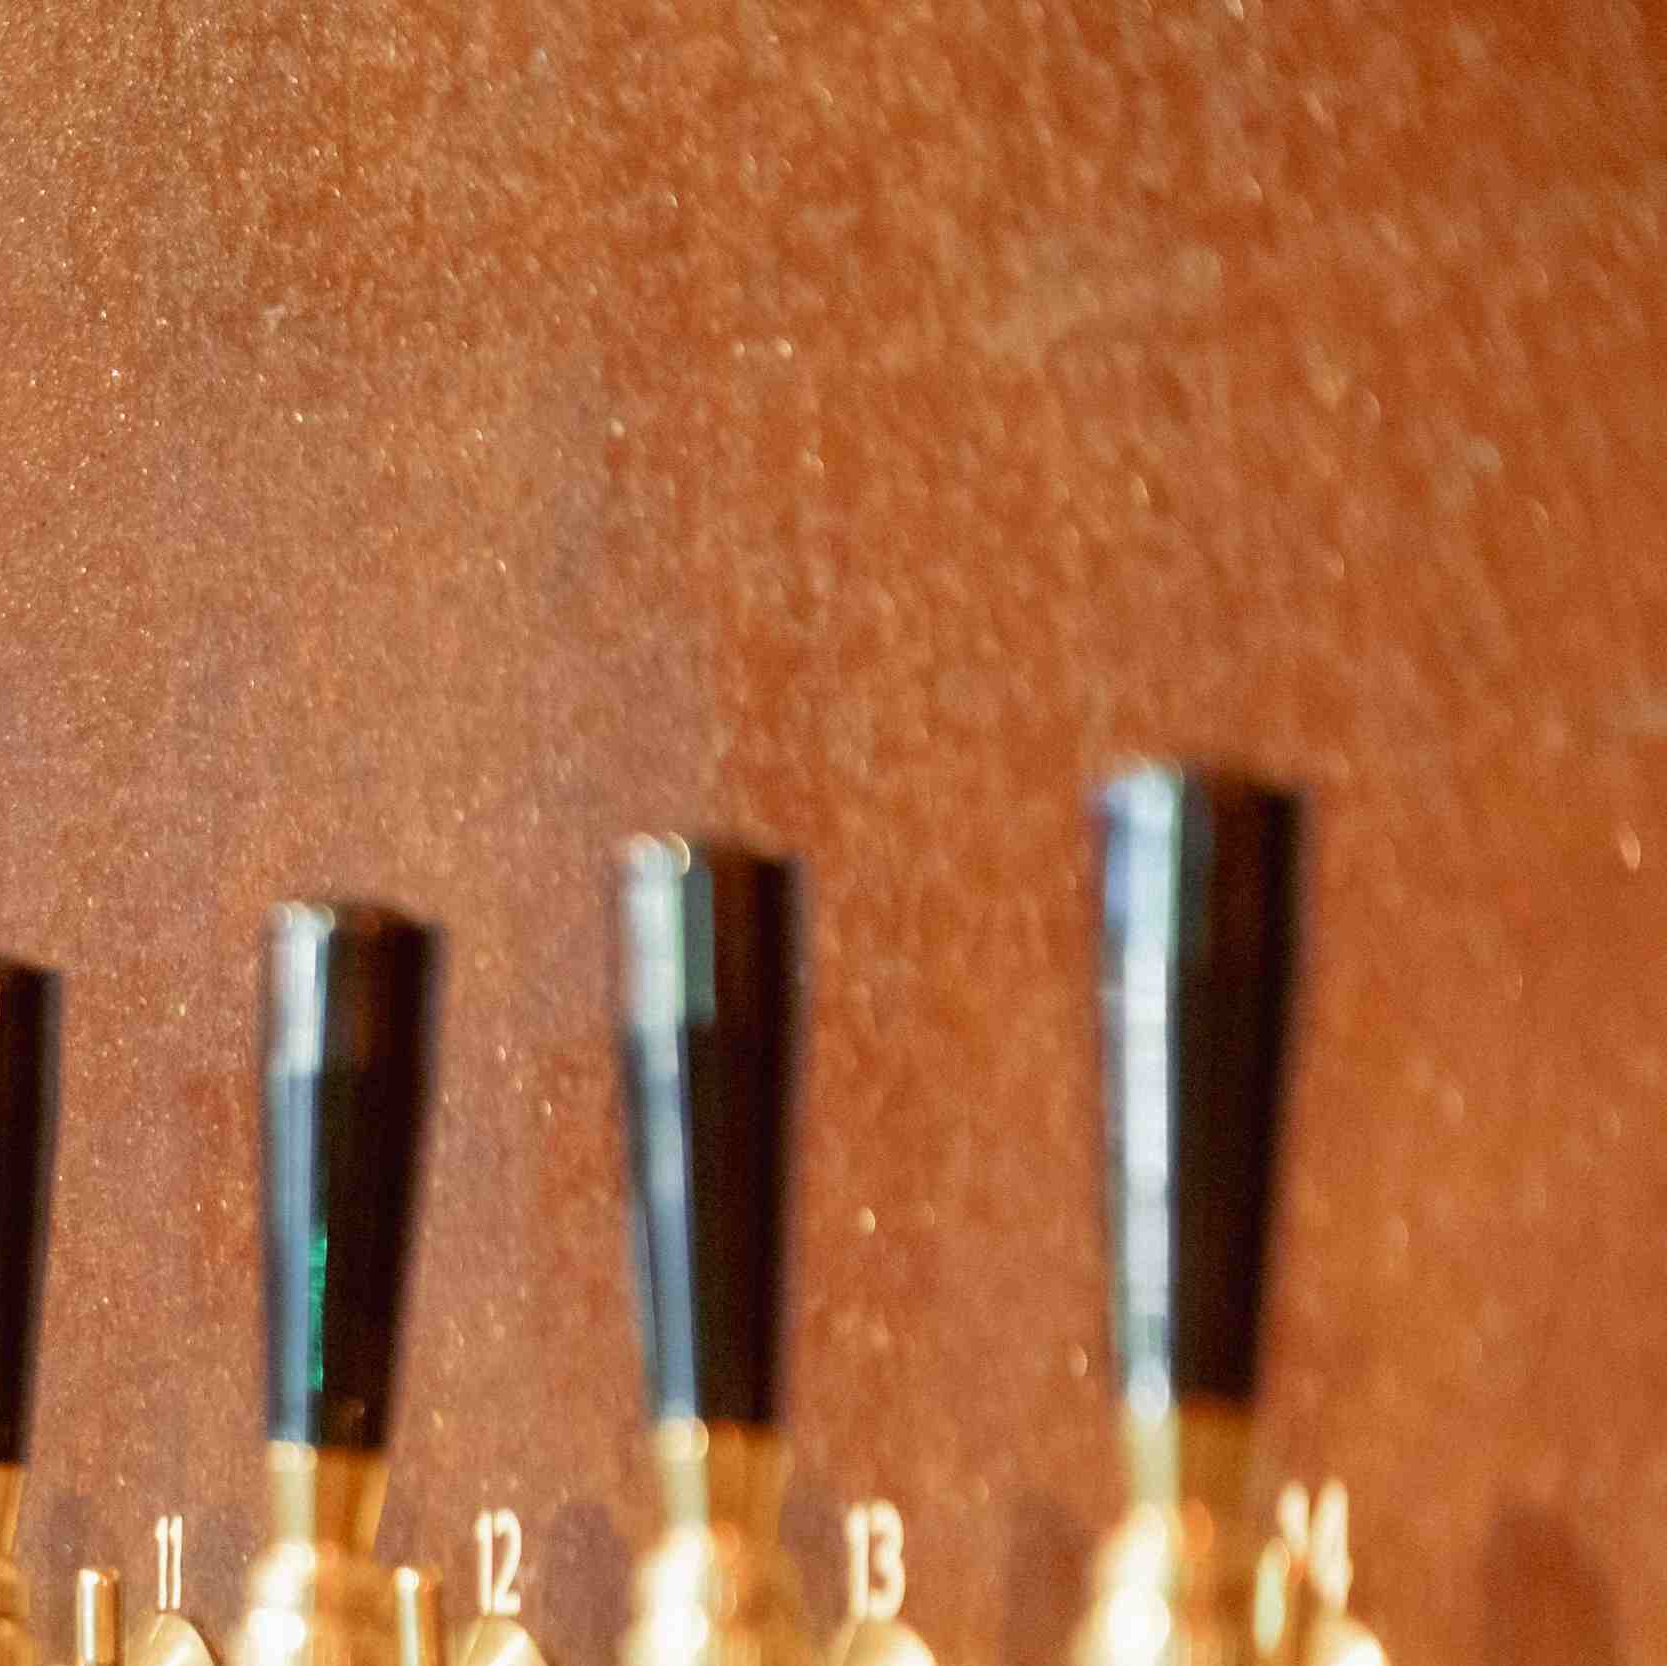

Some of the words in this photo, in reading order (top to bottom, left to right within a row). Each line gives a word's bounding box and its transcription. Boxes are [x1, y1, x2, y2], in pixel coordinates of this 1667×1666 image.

[154, 1514, 183, 1610] 11
[476, 1508, 522, 1615] 12
[845, 1499, 905, 1620] 13
